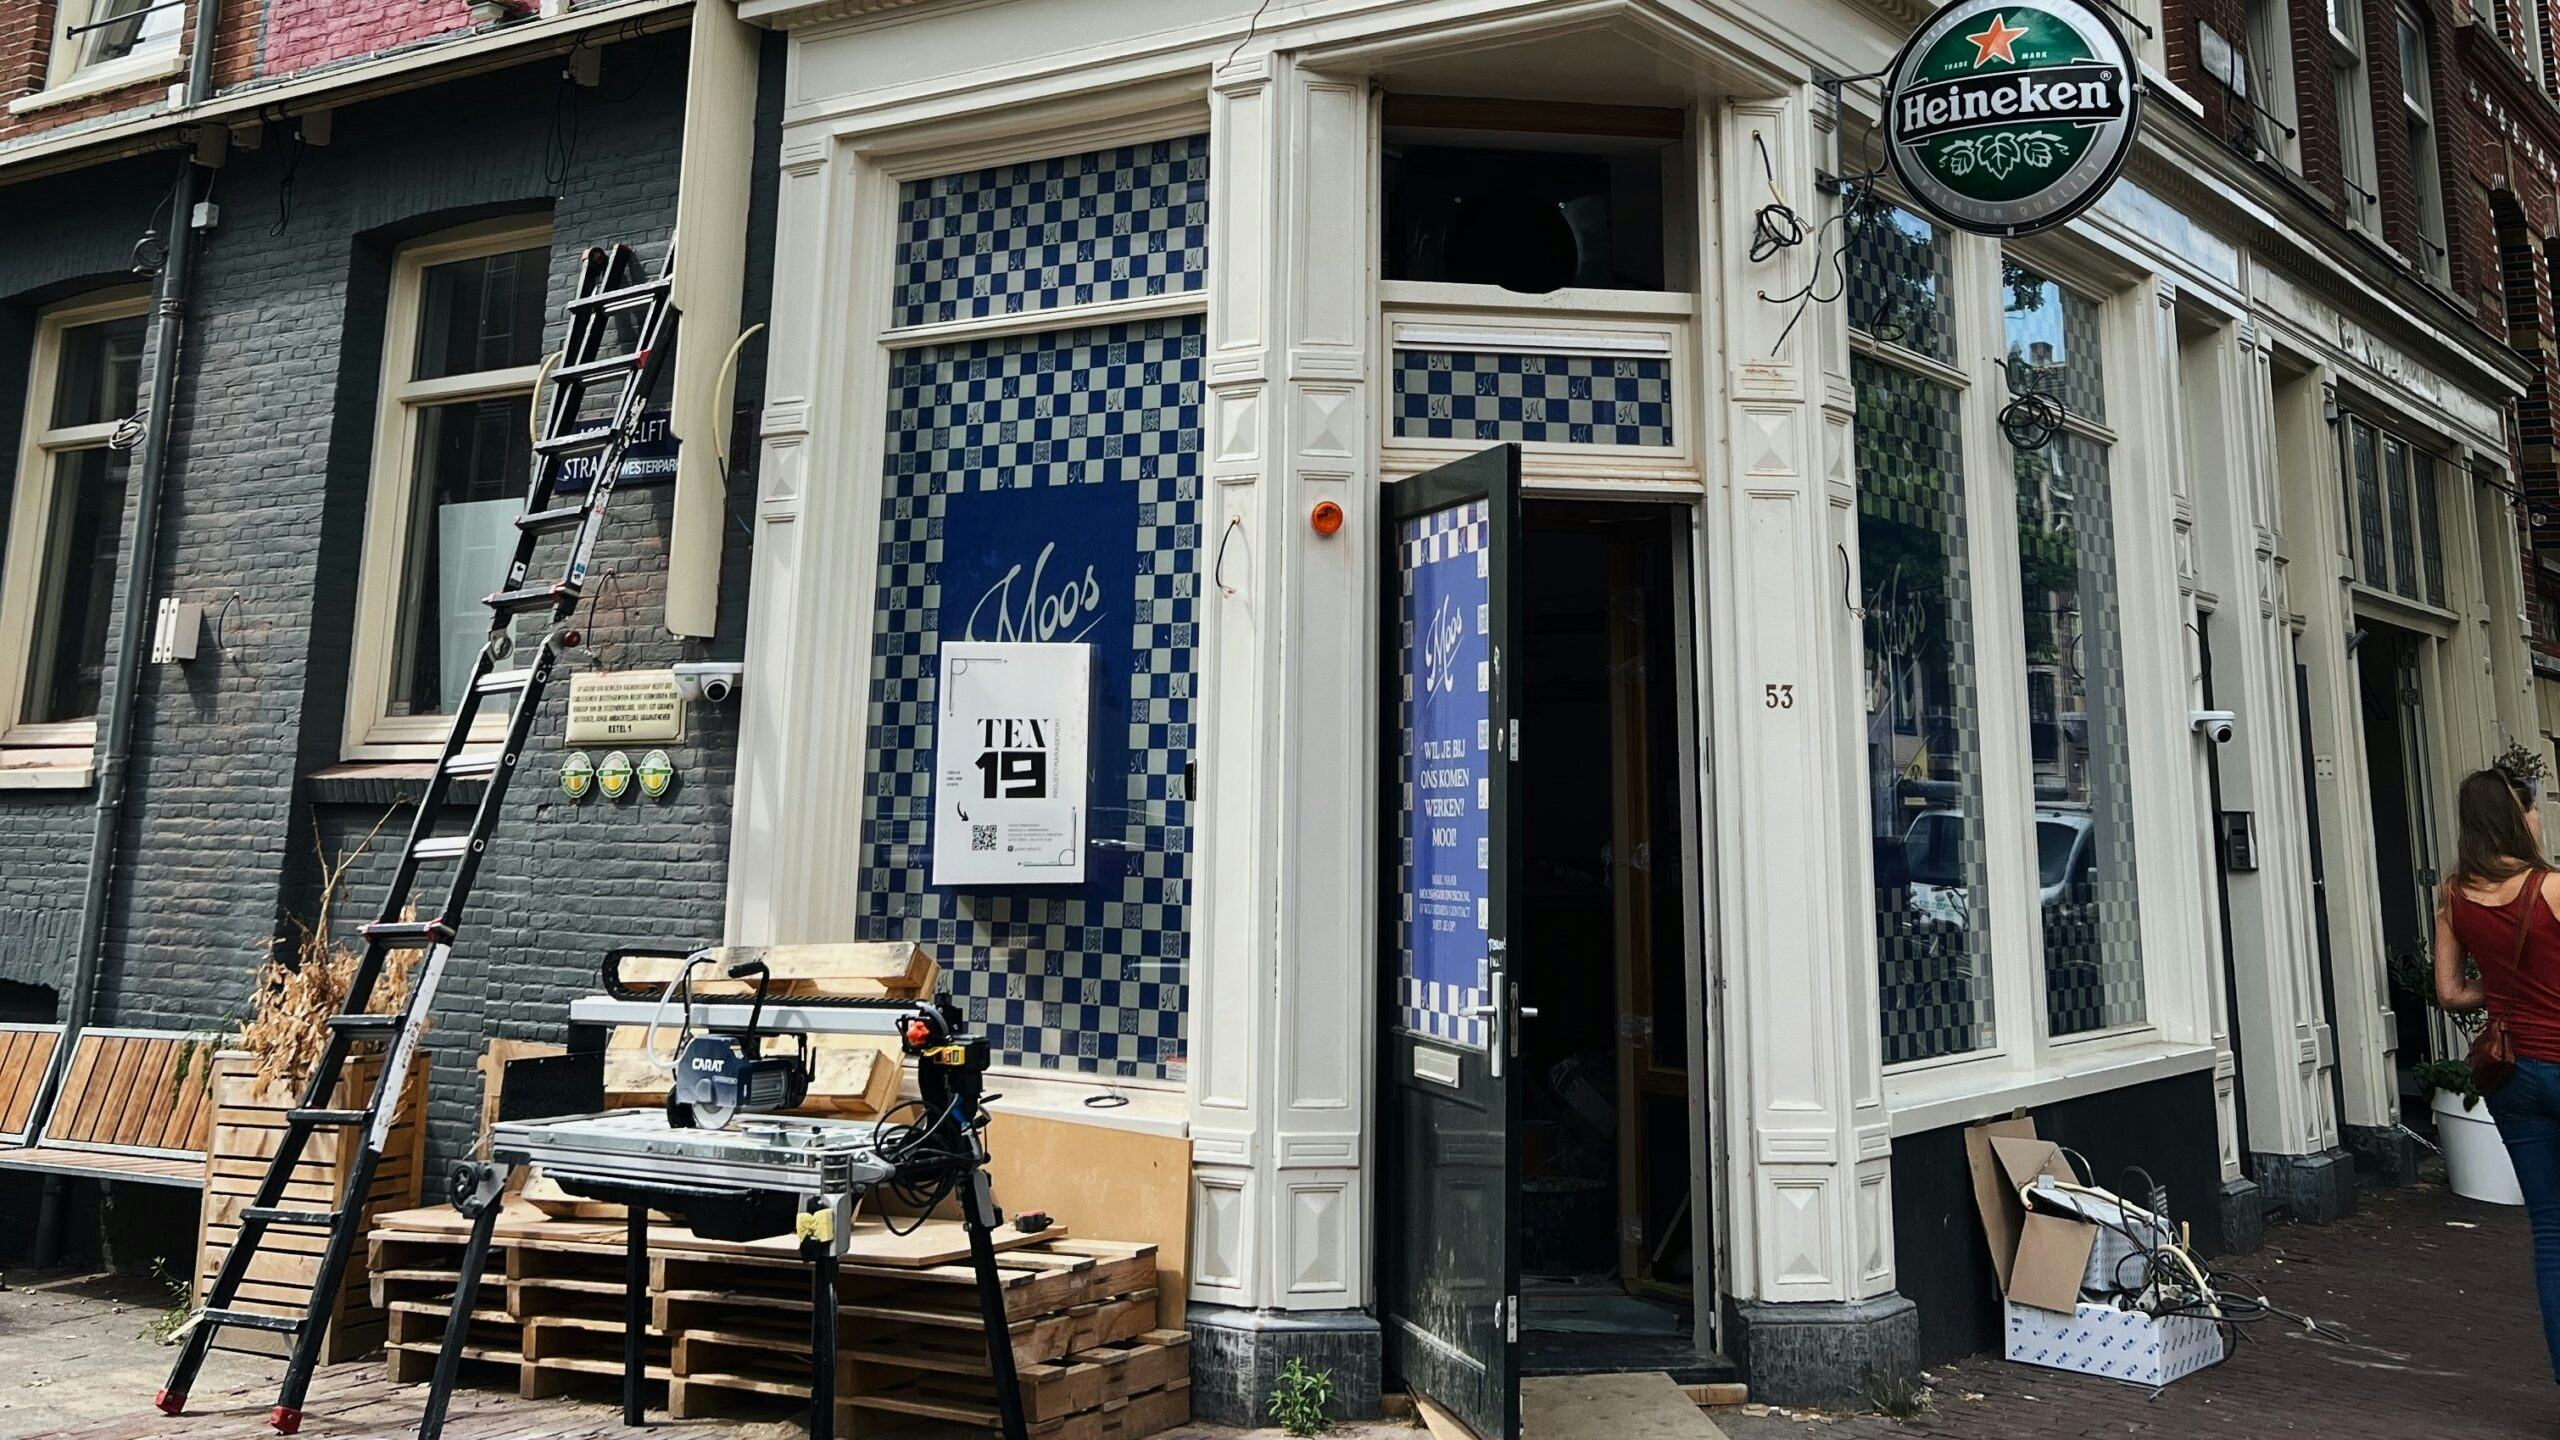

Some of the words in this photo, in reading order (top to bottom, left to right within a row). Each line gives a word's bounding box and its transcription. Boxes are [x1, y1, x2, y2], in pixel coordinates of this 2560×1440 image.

[1944, 60, 1968, 71] TRADE
[2021, 51, 2048, 60] MARK
[1903, 77, 2111, 132] Heineken
[1920, 177, 2003, 219] PREMIUM
[2019, 161, 2099, 216] QUALITY
[964, 541, 1100, 642] Moos
[1425, 594, 1462, 692] Moos
[1765, 684, 1793, 709] 53
[977, 718, 1049, 748] TEN
[1424, 742, 1440, 759] WIL
[1441, 740, 1452, 758] JE
[1453, 739, 1466, 757] BIJ
[975, 751, 1046, 798] 19
[1420, 770, 1438, 789] ONS
[1439, 768, 1470, 788] KOMEN
[1425, 798, 1465, 817] WERKEN?
[692, 1058, 724, 1072] CARAT
